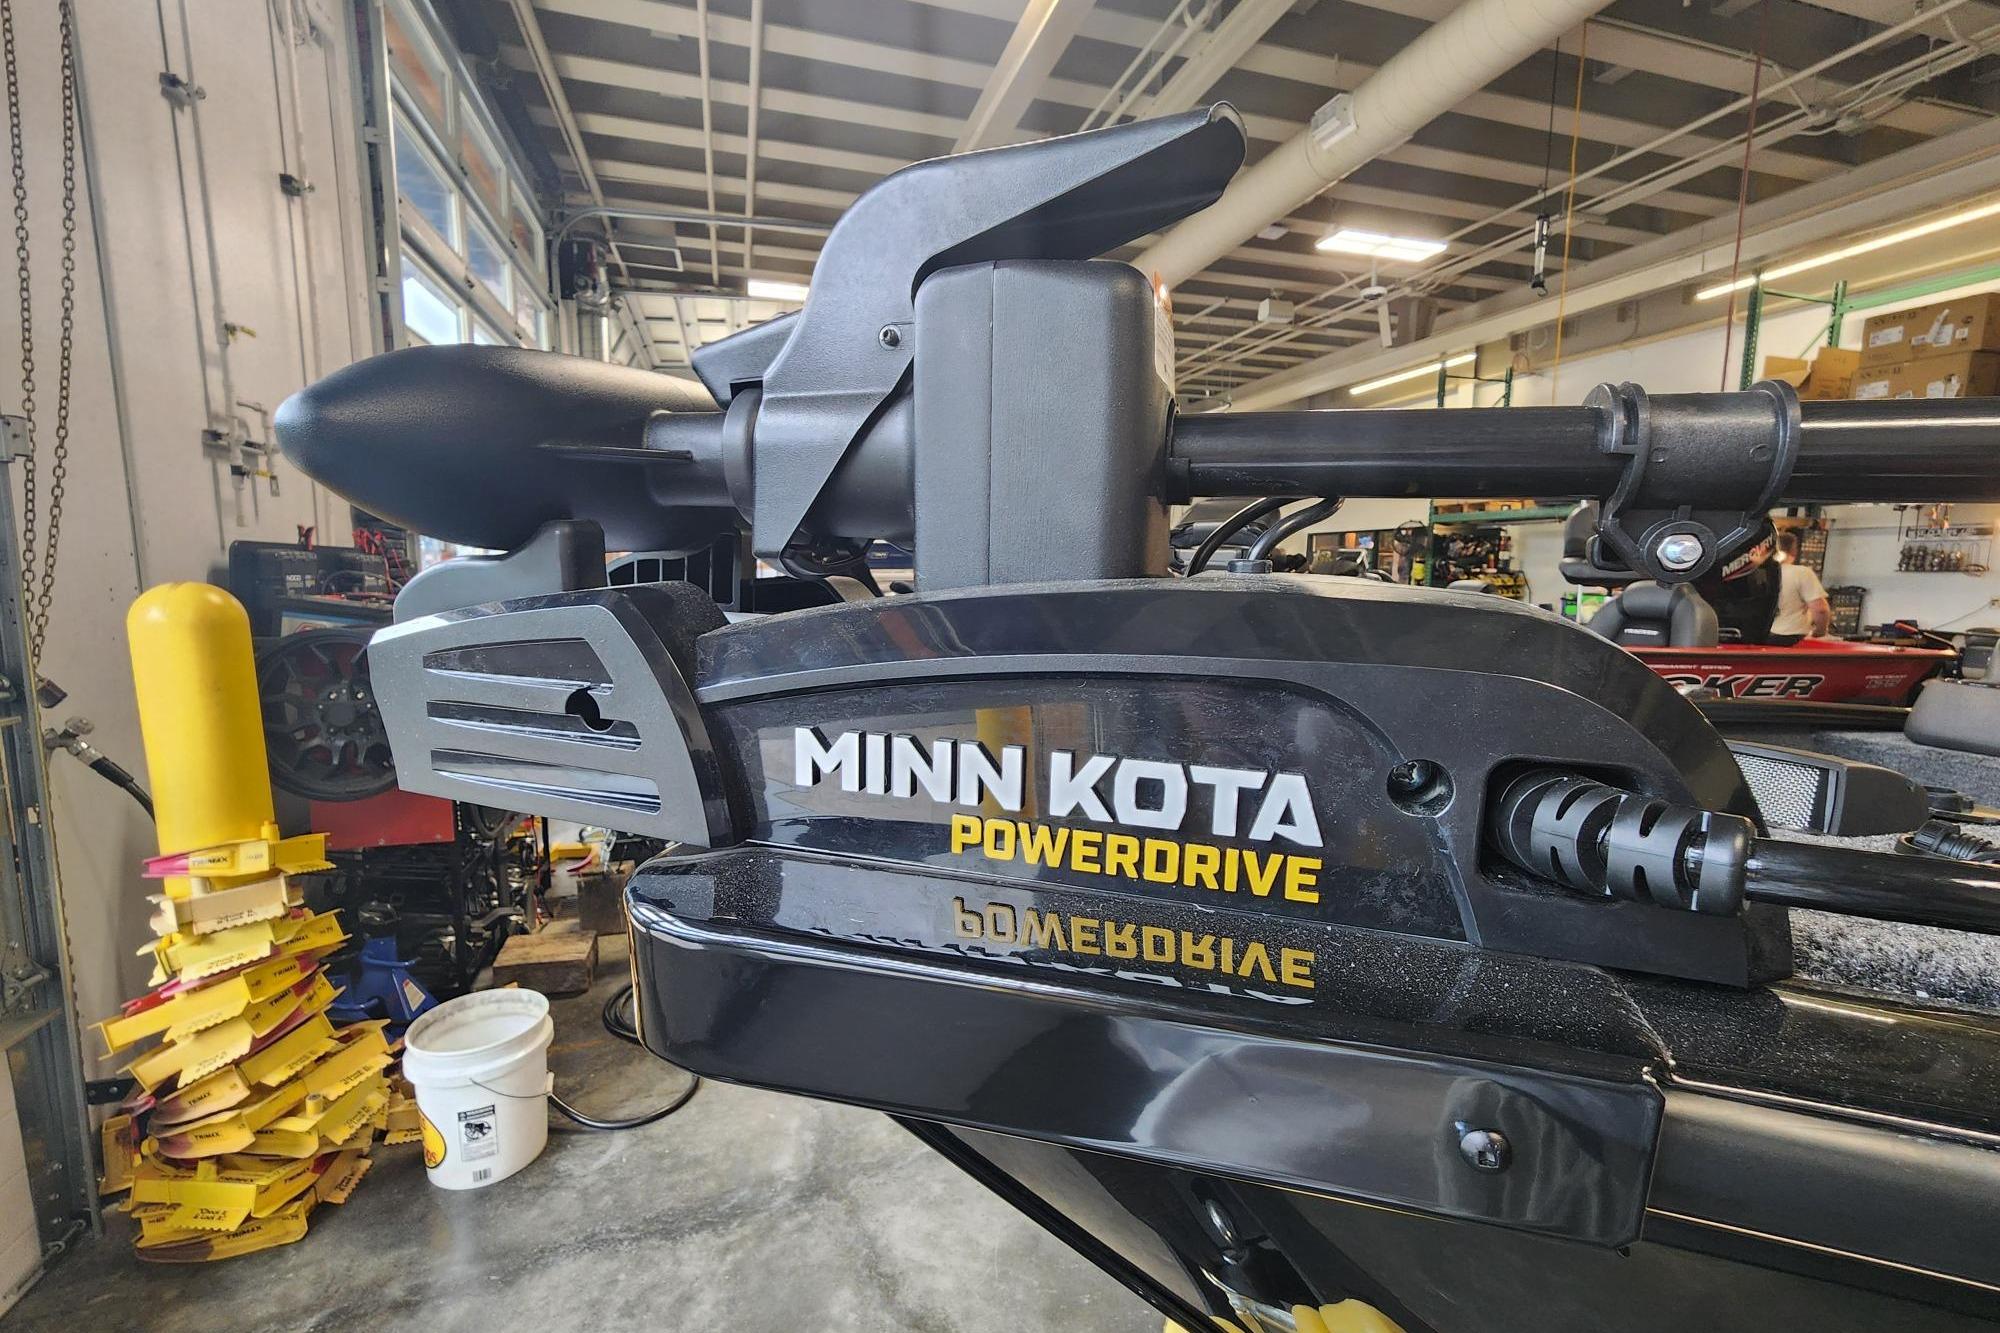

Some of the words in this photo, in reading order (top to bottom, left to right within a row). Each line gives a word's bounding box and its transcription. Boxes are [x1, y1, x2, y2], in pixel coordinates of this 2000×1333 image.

[794, 725, 1028, 813] MINN
[1049, 751, 1325, 848] KOTA
[951, 813, 1324, 904] POWERDRIVE
